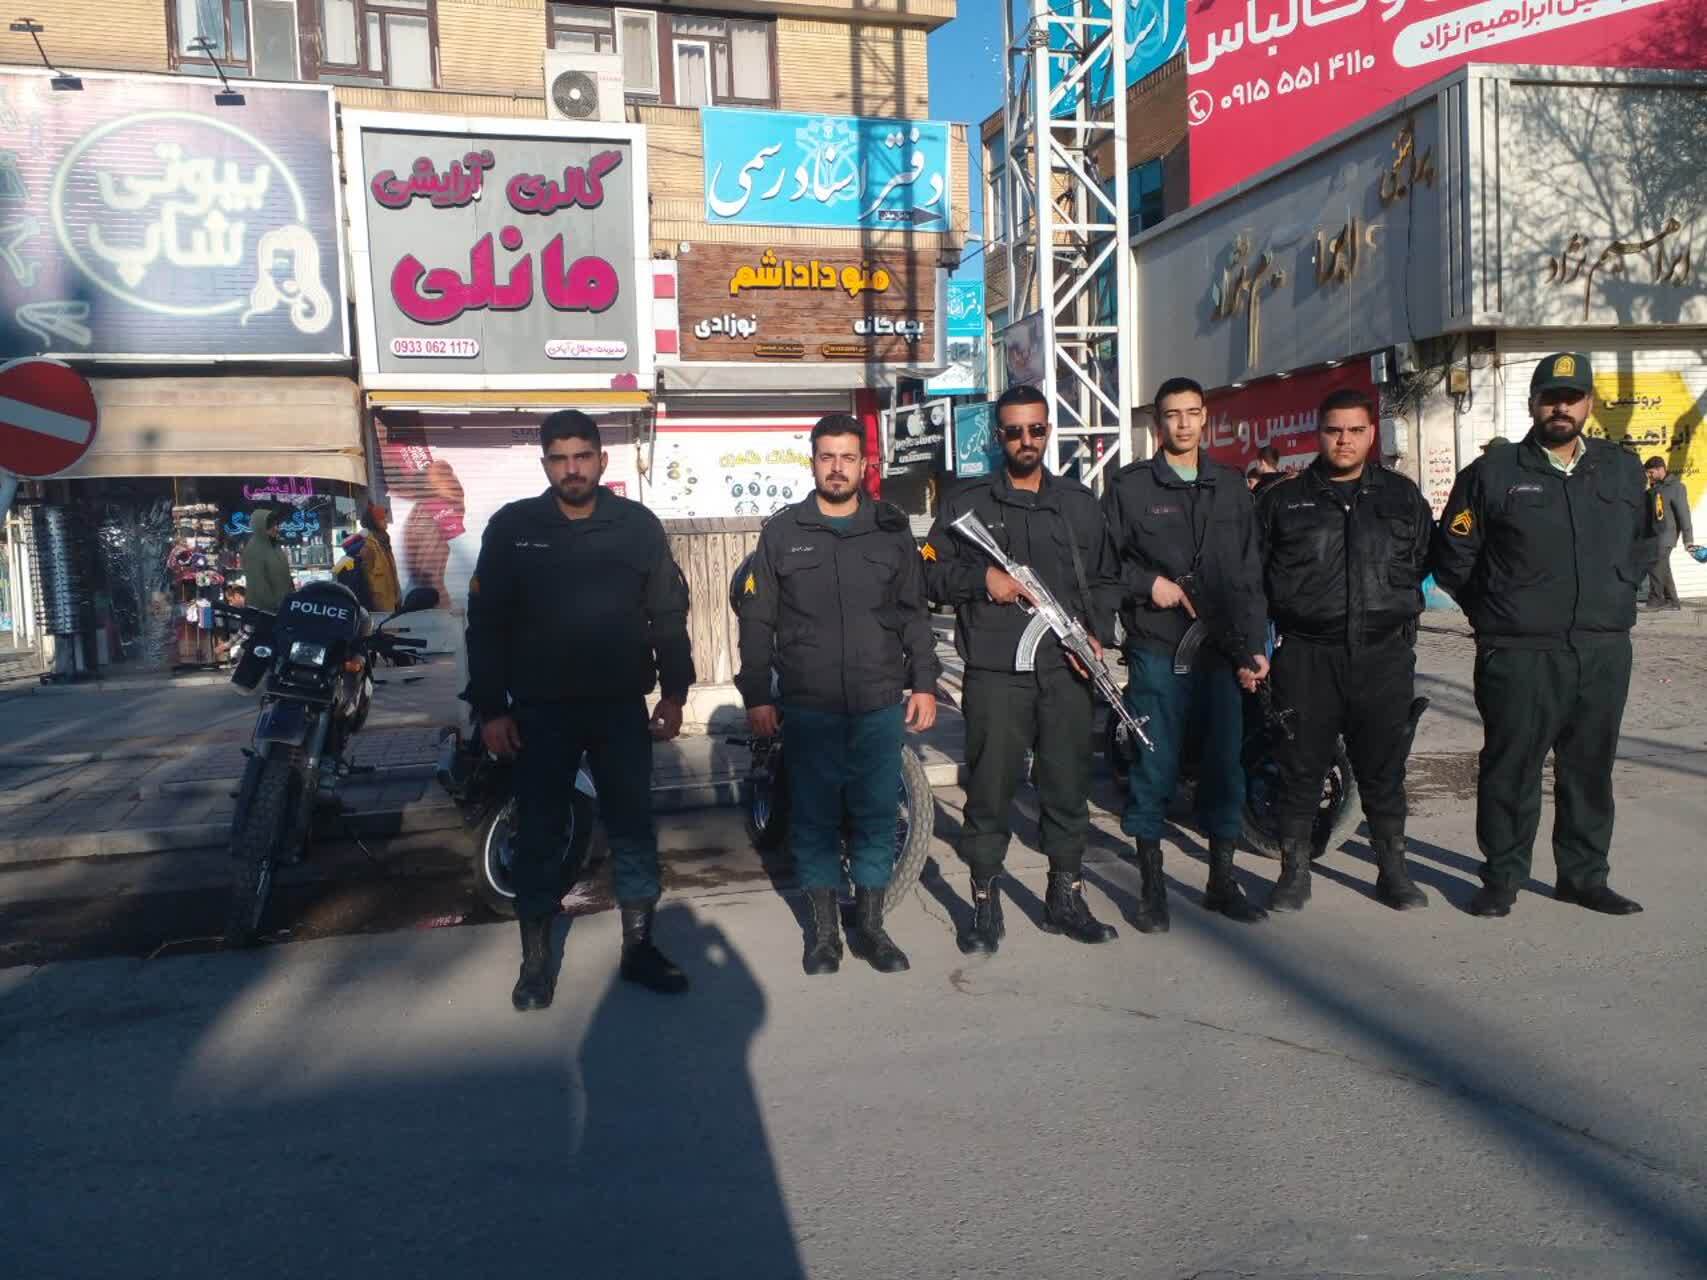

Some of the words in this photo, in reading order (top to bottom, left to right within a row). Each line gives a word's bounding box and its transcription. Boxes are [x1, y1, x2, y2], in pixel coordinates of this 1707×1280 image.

[1420, 20, 1461, 50] نژاد
[1221, 78, 1270, 109] ۰۹۱۵
[1277, 61, 1320, 94] ۵۵۱
[1328, 49, 1375, 80] ۴۱۱۰
[97, 142, 271, 214] بیوتی
[371, 149, 495, 209] آرایشی
[506, 150, 623, 215] گالری
[709, 143, 785, 217] رسمی
[789, 145, 866, 202] اسناد
[858, 127, 944, 221] دفتر
[88, 206, 246, 287] شاپ
[729, 248, 837, 297] داداشم
[840, 260, 890, 298] منو
[394, 341, 422, 353] 0933
[425, 341, 446, 353] 062
[450, 341, 475, 354] 1171
[694, 313, 758, 339] نوزادی
[290, 600, 349, 620] POLICE
